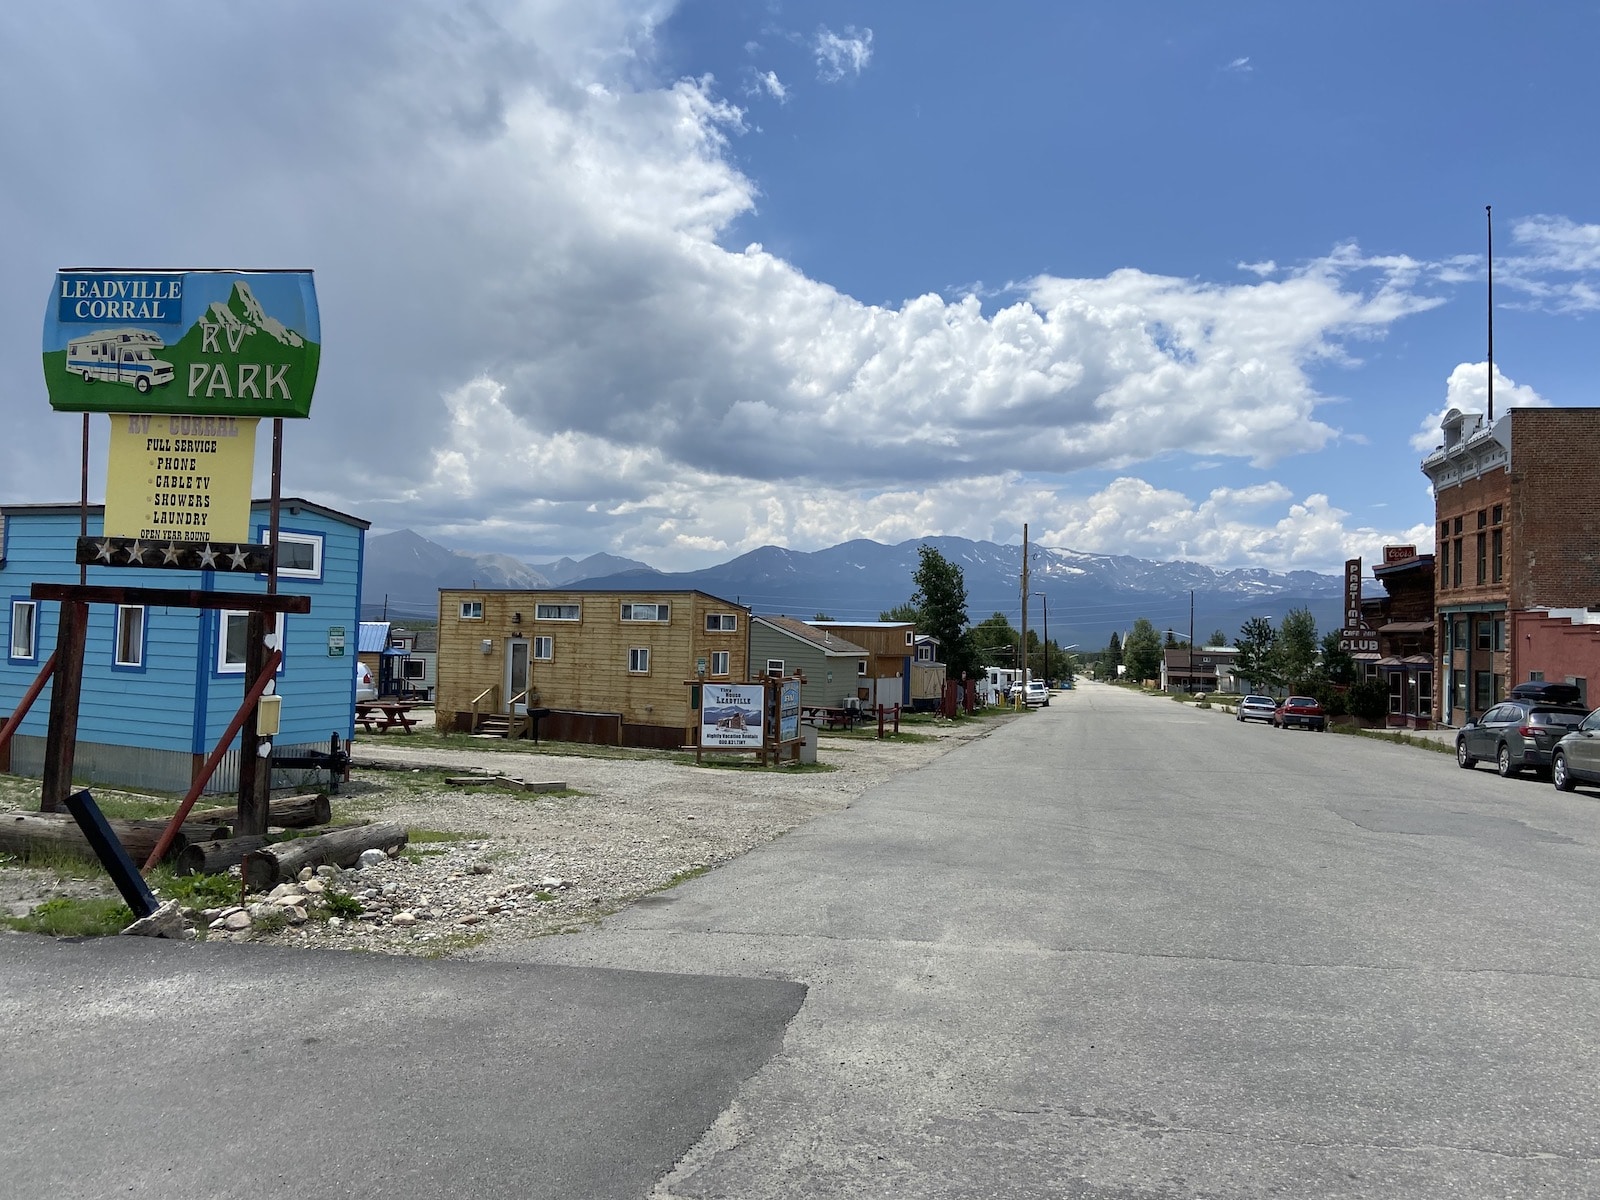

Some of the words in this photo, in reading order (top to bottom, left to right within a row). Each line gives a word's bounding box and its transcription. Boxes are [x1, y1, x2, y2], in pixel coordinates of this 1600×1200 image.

[60, 280, 182, 299] LEADVILLE
[75, 299, 166, 319] CORRAL
[202, 322, 247, 353] RV
[187, 363, 292, 400] PARK
[128, 414, 152, 434] RV
[169, 416, 239, 437] CORRAL
[146, 438, 171, 452] FULL
[174, 440, 217, 453] SERVICE
[157, 457, 196, 471] PHONE
[155, 475, 193, 489] CABLE
[195, 477, 211, 490] TV
[154, 493, 210, 508] SHOWERS
[153, 511, 208, 526] LAUNDRY
[140, 529, 161, 540] OPEN
[162, 530, 183, 540] YEAR
[184, 531, 211, 541] ROUND
[1389, 549, 1413, 558] Coors
[1348, 565, 1358, 626] PASTIME
[1340, 640, 1378, 651] CLUB
